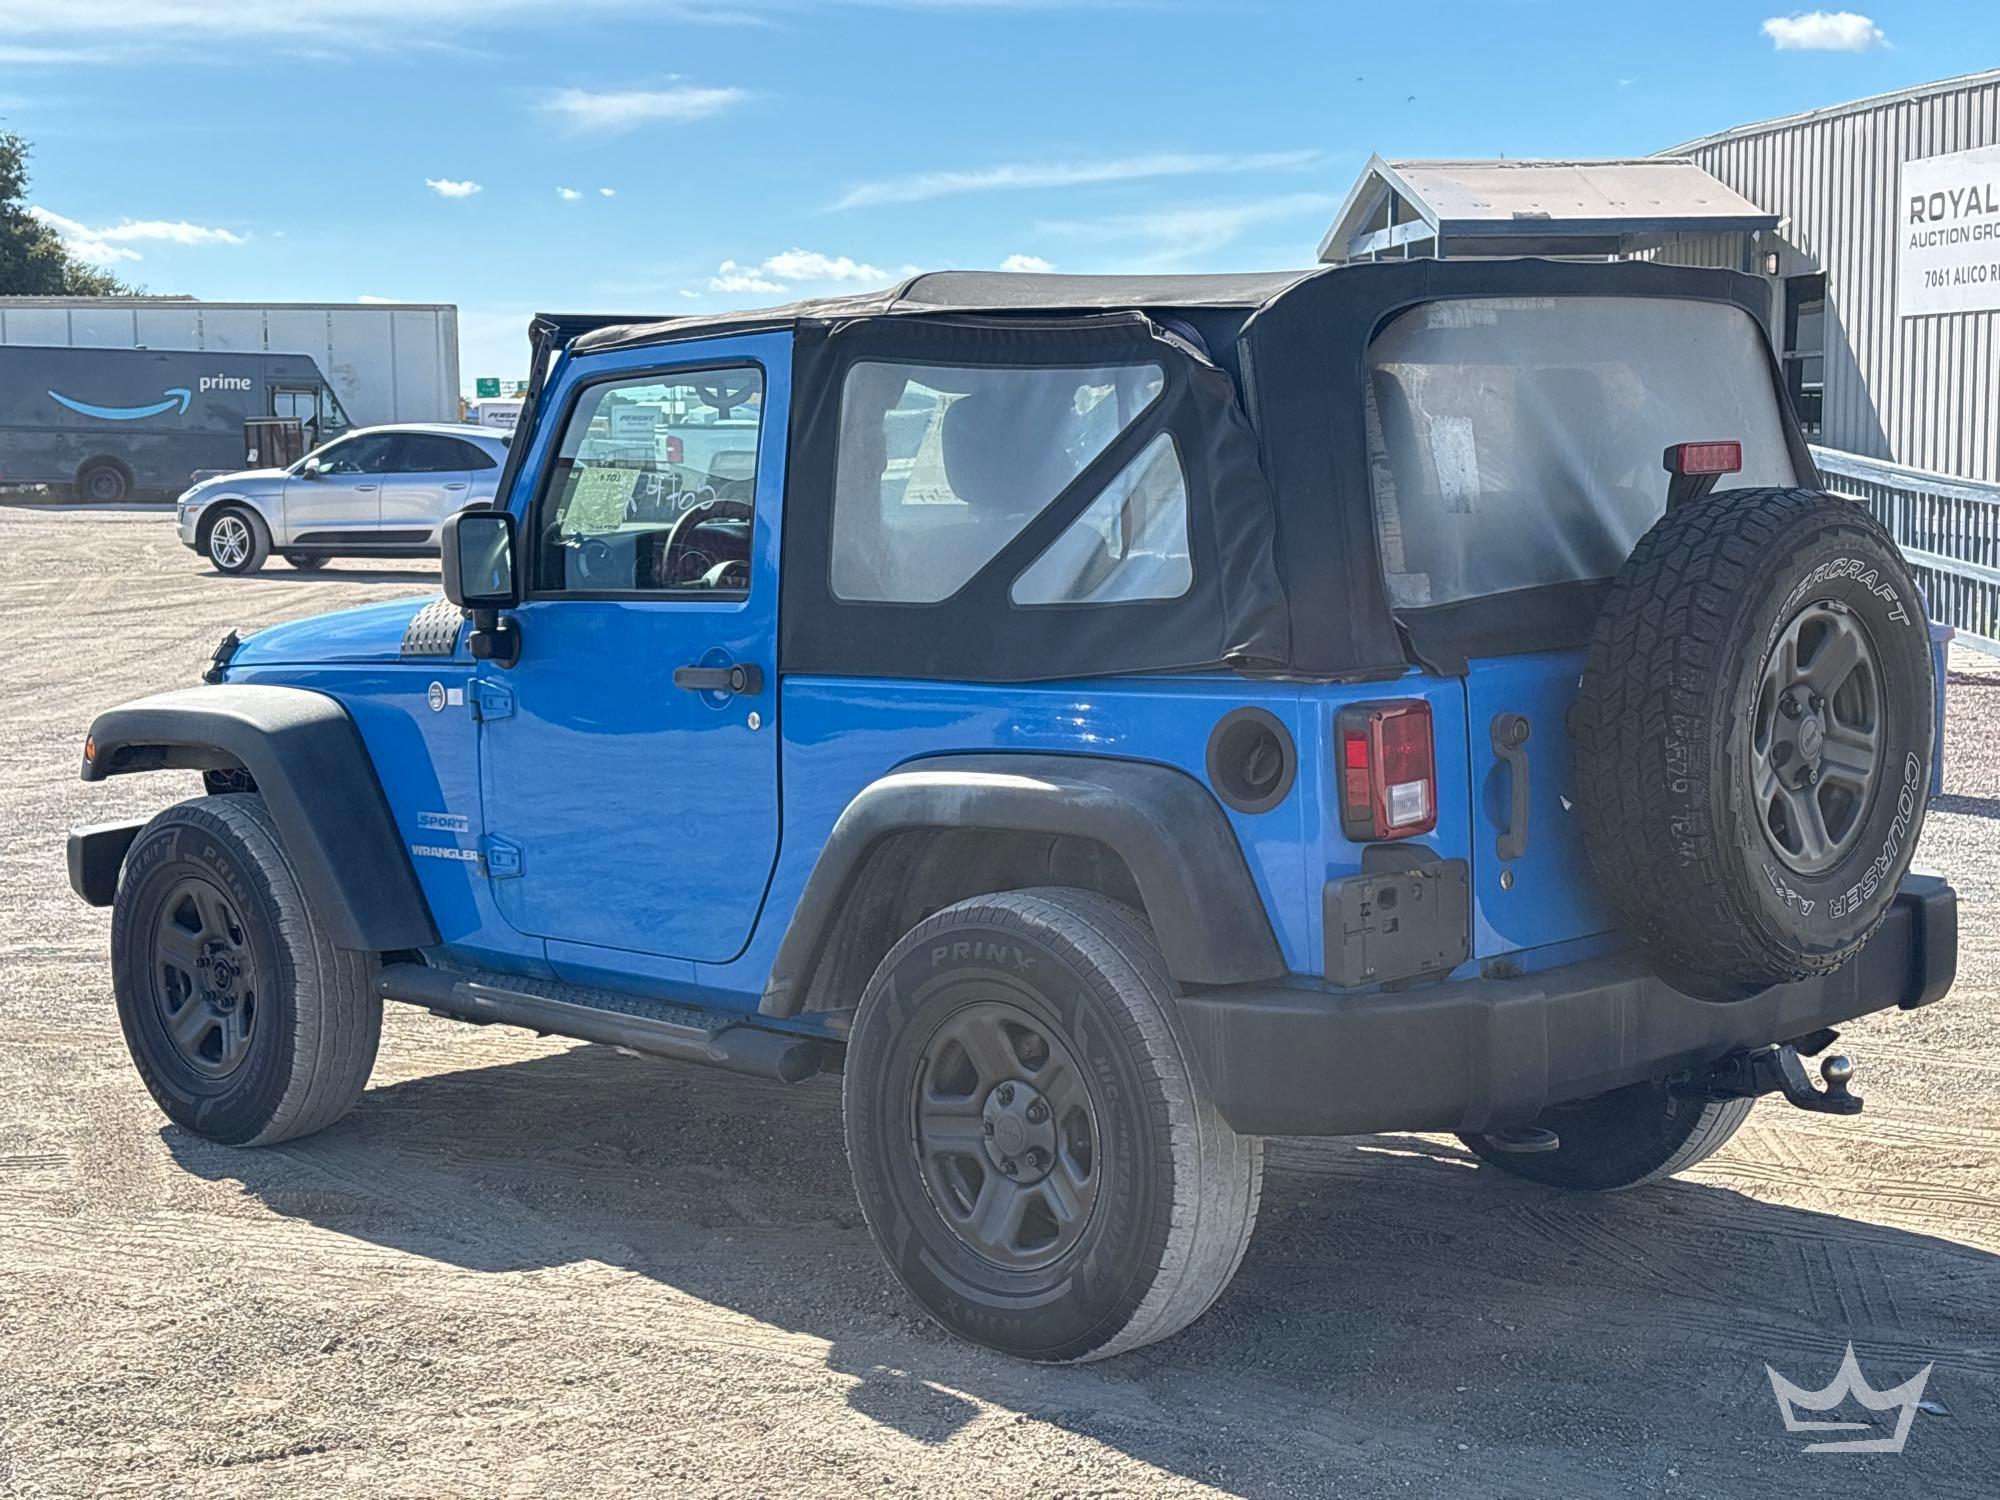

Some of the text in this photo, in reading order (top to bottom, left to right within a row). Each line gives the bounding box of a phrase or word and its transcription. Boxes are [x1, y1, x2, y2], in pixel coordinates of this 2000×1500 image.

[1910, 183, 1999, 225] ROYAL
[1909, 225, 1970, 250] AUCTION
[1924, 263, 2000, 289] 7061 ALICO R
[199, 373, 252, 393] prime
[418, 814, 468, 829] SPORT
[1828, 751, 1921, 919] COURSER
[411, 844, 479, 862] WRANGLER
[1762, 863, 1815, 917] AXT
[931, 941, 1037, 972] PRINX
